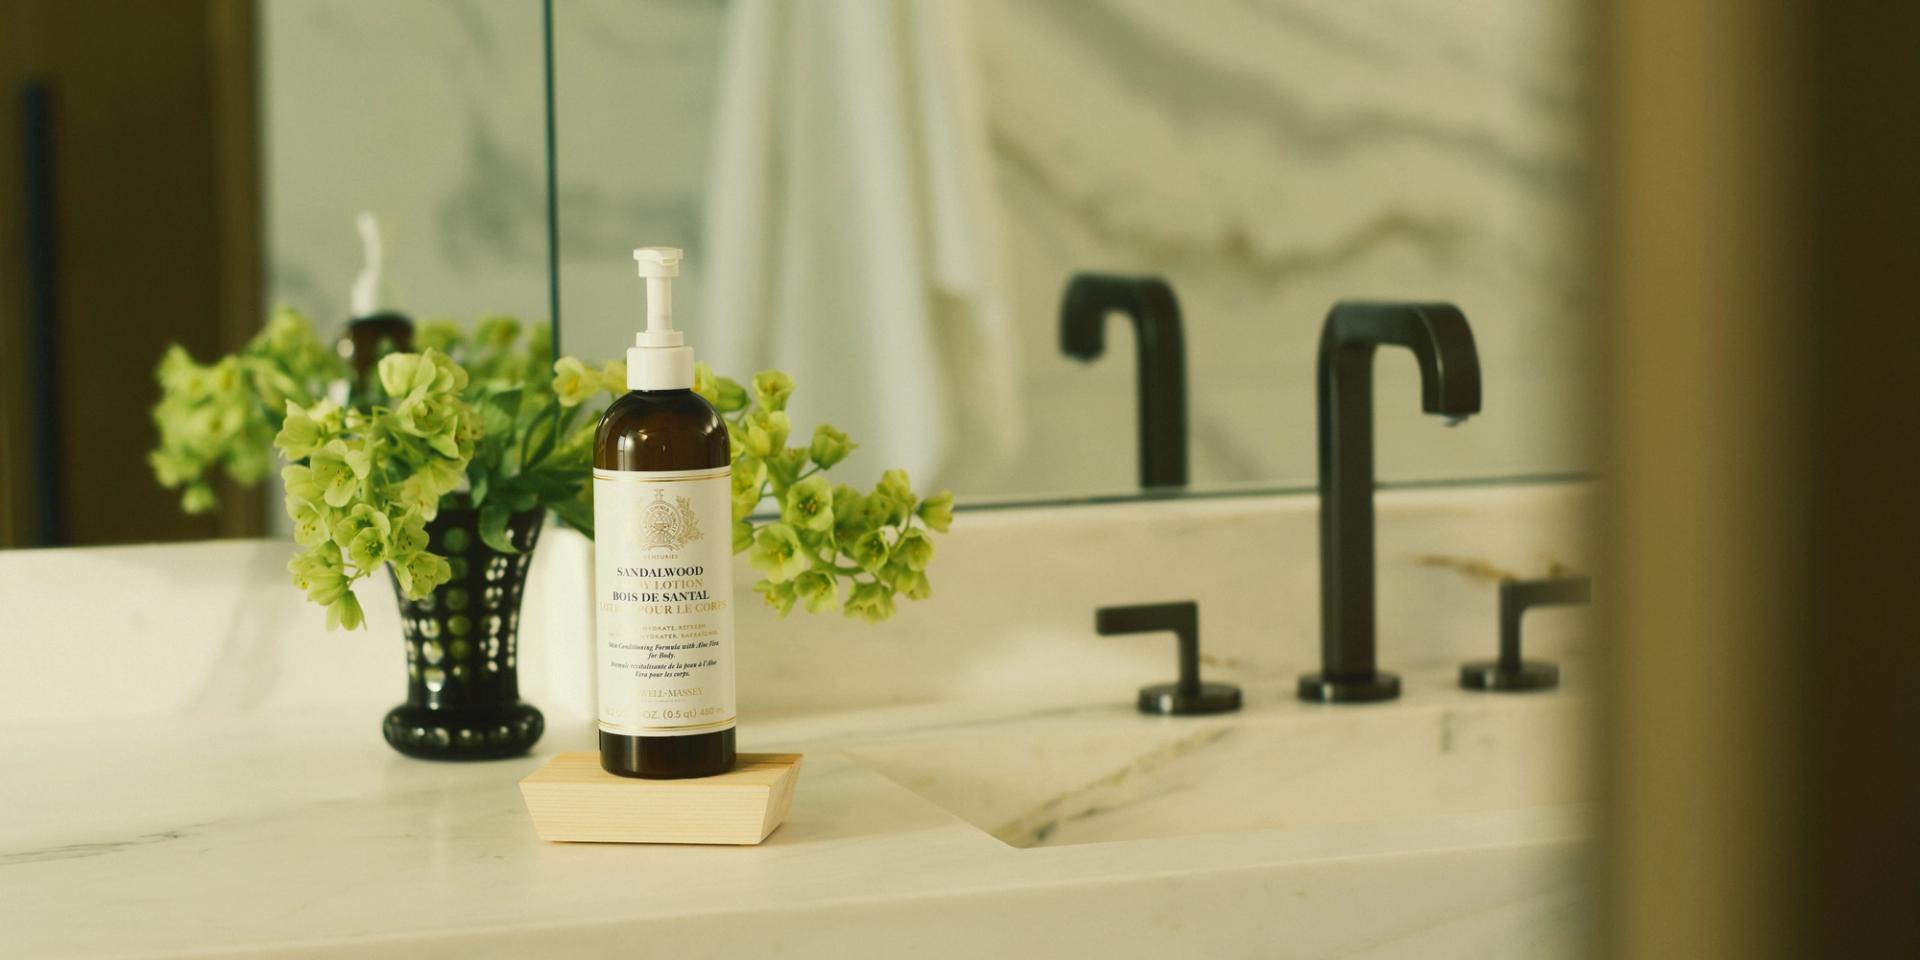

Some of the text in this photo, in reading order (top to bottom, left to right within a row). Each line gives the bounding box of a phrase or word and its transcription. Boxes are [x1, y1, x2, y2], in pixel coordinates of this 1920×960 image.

[617, 566, 704, 578] SANDALWOOD
[655, 579, 704, 590] LOTION
[613, 590, 710, 602] BOIS DE SANTAL
[677, 604, 692, 614] LE
[654, 643, 681, 651] Formula
[681, 642, 695, 650] with
[648, 671, 664, 679] pour
[663, 709, 681, 720] (0.5
